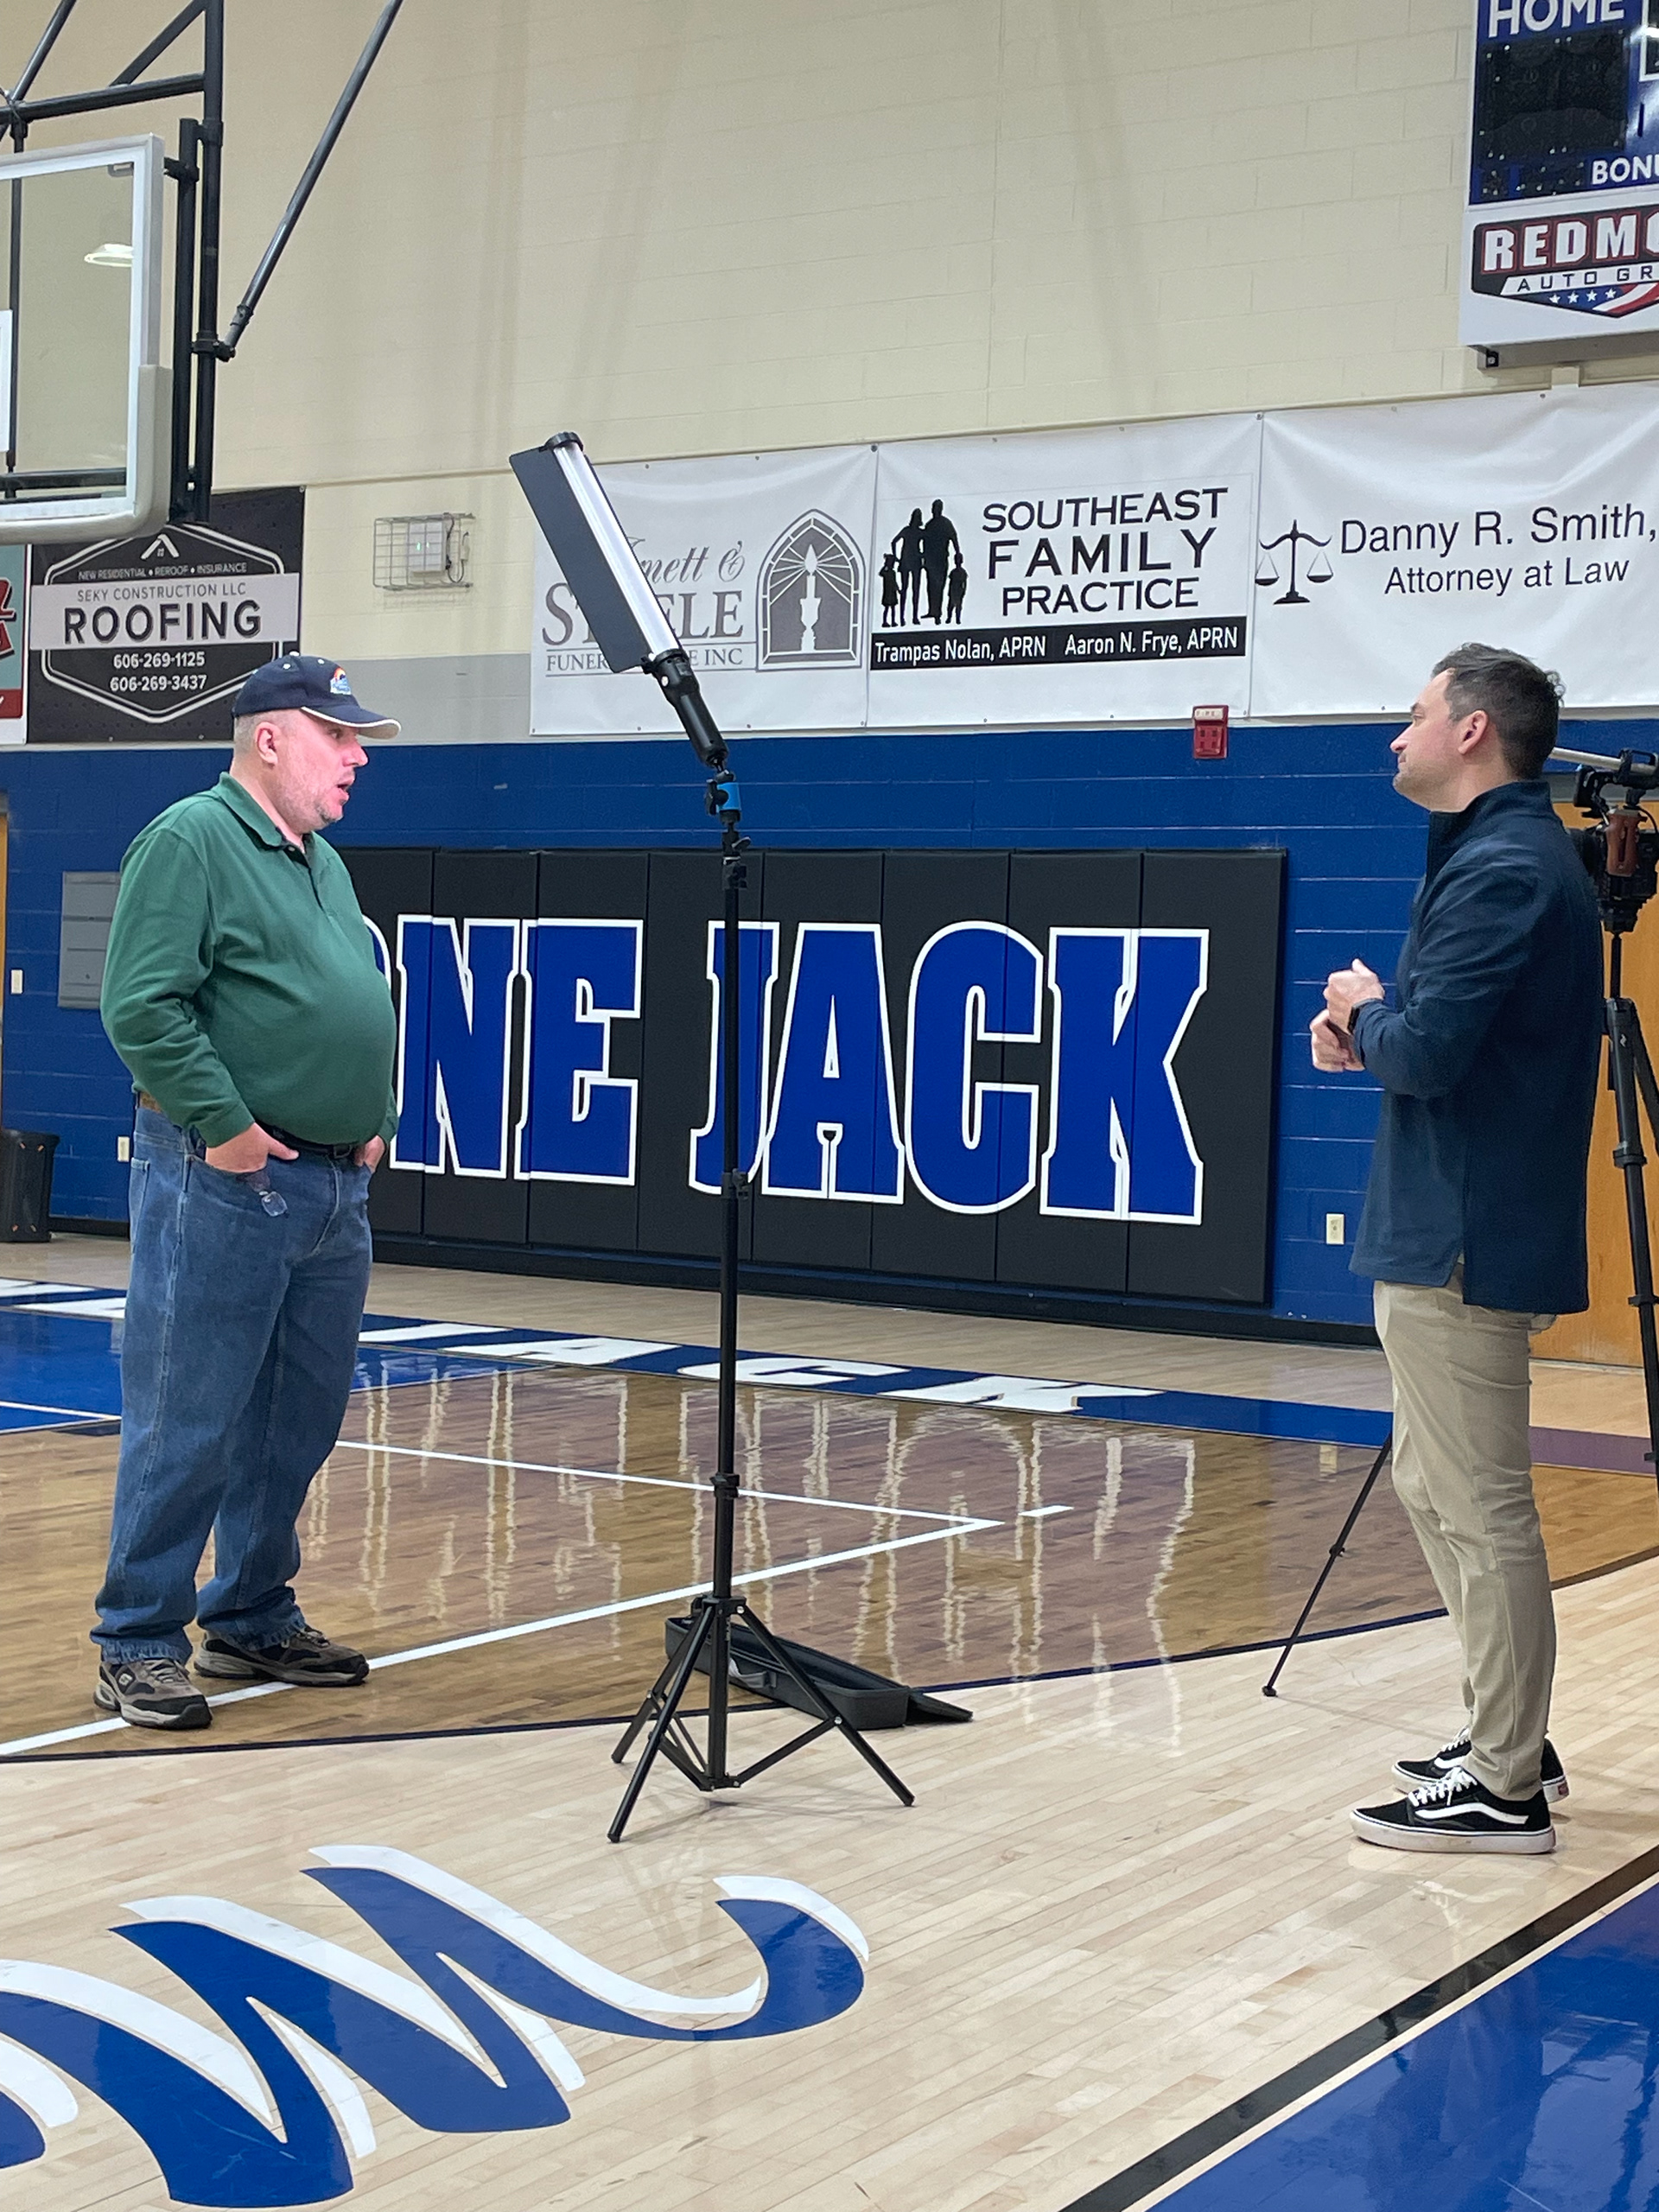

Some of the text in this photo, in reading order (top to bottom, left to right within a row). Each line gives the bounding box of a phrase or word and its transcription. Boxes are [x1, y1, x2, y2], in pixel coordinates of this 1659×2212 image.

[1592, 154, 1659, 185] BON
[1517, 270, 1598, 293] AUTO
[982, 486, 1229, 533] SOUTHEAST
[1340, 503, 1657, 558] Danny R. Smith,
[79, 562, 247, 582] NEW RESIDENTIAL REROOF INSURANCE
[718, 540, 746, 583] &
[988, 527, 1217, 580] FAMILY
[77, 582, 246, 602] SEKY CONSTRUCTION LLC
[1002, 576, 1200, 617] PRACTICE
[1384, 556, 1630, 597] Attorney at Law
[64, 600, 262, 645] ROOFING
[704, 648, 744, 666] INC
[874, 626, 1238, 667] Trampas Nolan, APRN Aaron N. Frye, APRN
[363, 913, 1211, 1225] NE JACK
